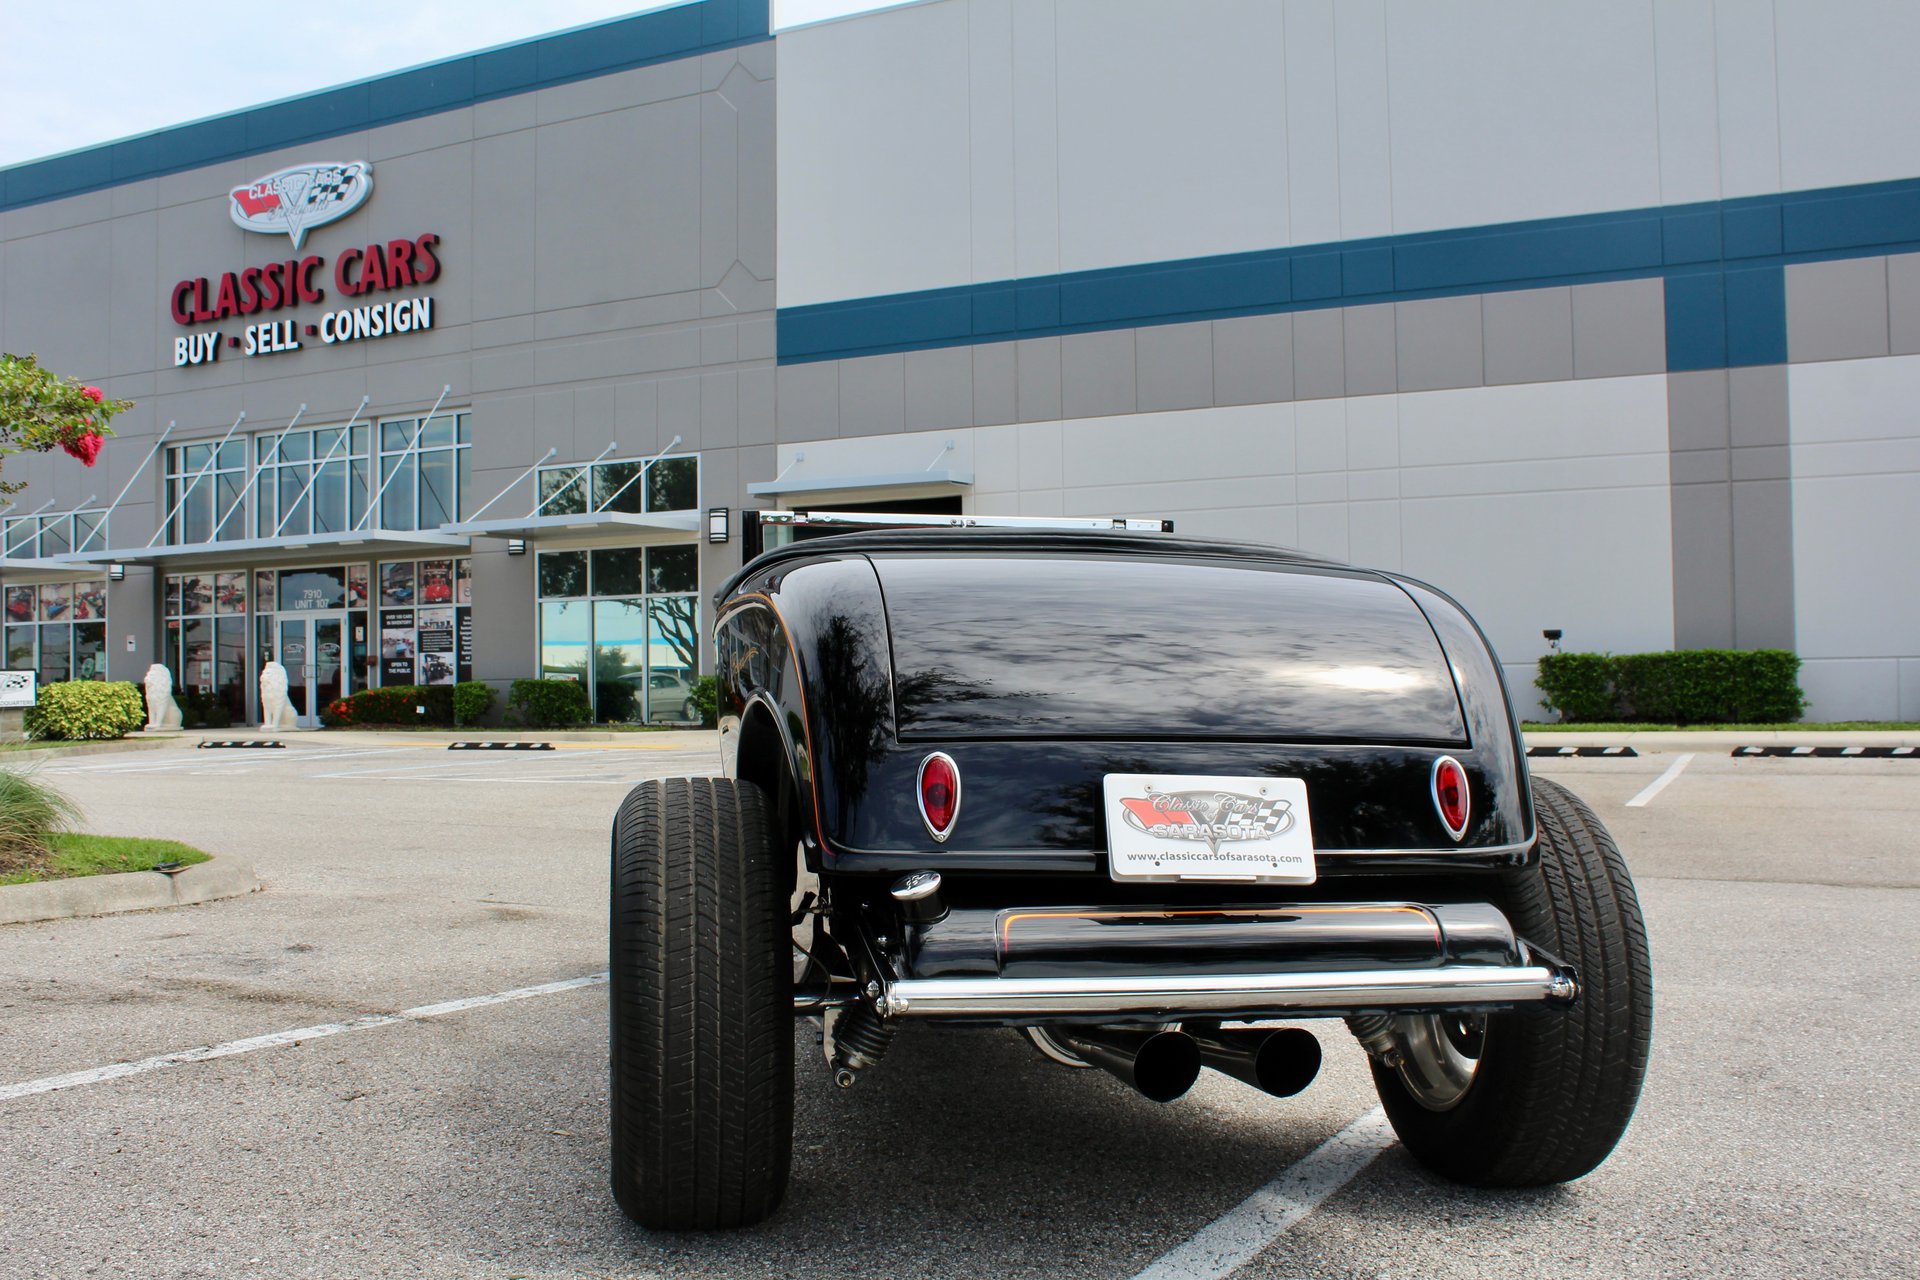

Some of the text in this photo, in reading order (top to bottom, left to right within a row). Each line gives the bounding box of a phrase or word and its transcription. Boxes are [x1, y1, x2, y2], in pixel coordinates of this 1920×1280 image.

[248, 177, 303, 200] CLASSIC
[171, 233, 440, 325] CLASSIC CARS
[174, 296, 432, 367] BUY SELL CONSIGN
[294, 599, 330, 609] UNIT 107
[303, 589, 322, 599] 7910
[1147, 791, 1258, 815] Classic Cars
[1152, 823, 1271, 841] SARASOTA
[1127, 851, 1302, 864] www.classiccarsofsarasota.com
